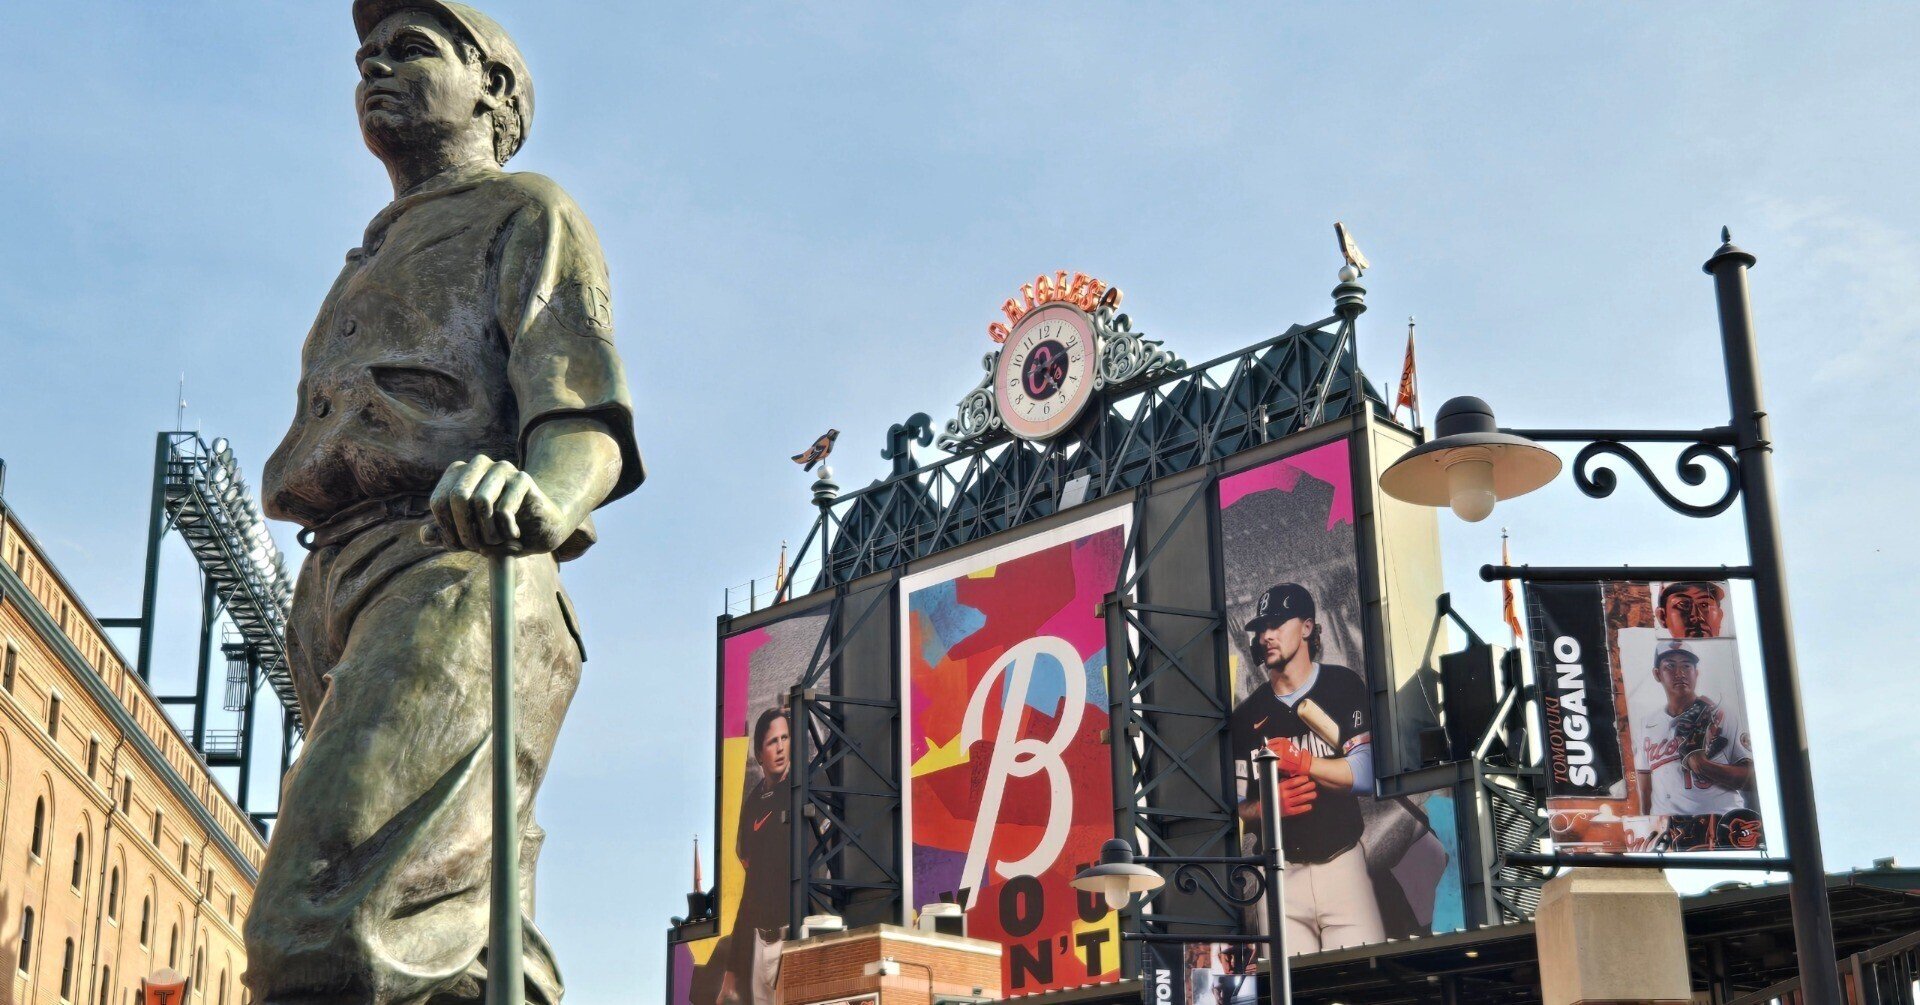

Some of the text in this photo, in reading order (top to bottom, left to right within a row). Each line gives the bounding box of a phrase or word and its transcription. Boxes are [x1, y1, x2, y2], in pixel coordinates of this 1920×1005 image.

[987, 270, 1107, 343] ORIOLES
[1039, 325, 1050, 340] 12
[1056, 325, 1062, 338] 1
[1023, 336, 1034, 350] 11
[1065, 335, 1078, 349] 2
[1013, 354, 1024, 367] 10
[1070, 354, 1081, 363] 3
[1010, 378, 1020, 387] 9
[1069, 375, 1078, 383] 4
[1015, 393, 1025, 405] 8
[1058, 391, 1066, 404] 5
[1026, 402, 1036, 415] 7
[1043, 401, 1051, 415] 6
[1553, 635, 1598, 788] SUGANO
[1545, 696, 1569, 784] TOMOYUKI
[960, 635, 1087, 911] B
[1010, 928, 1110, 989] N'T
